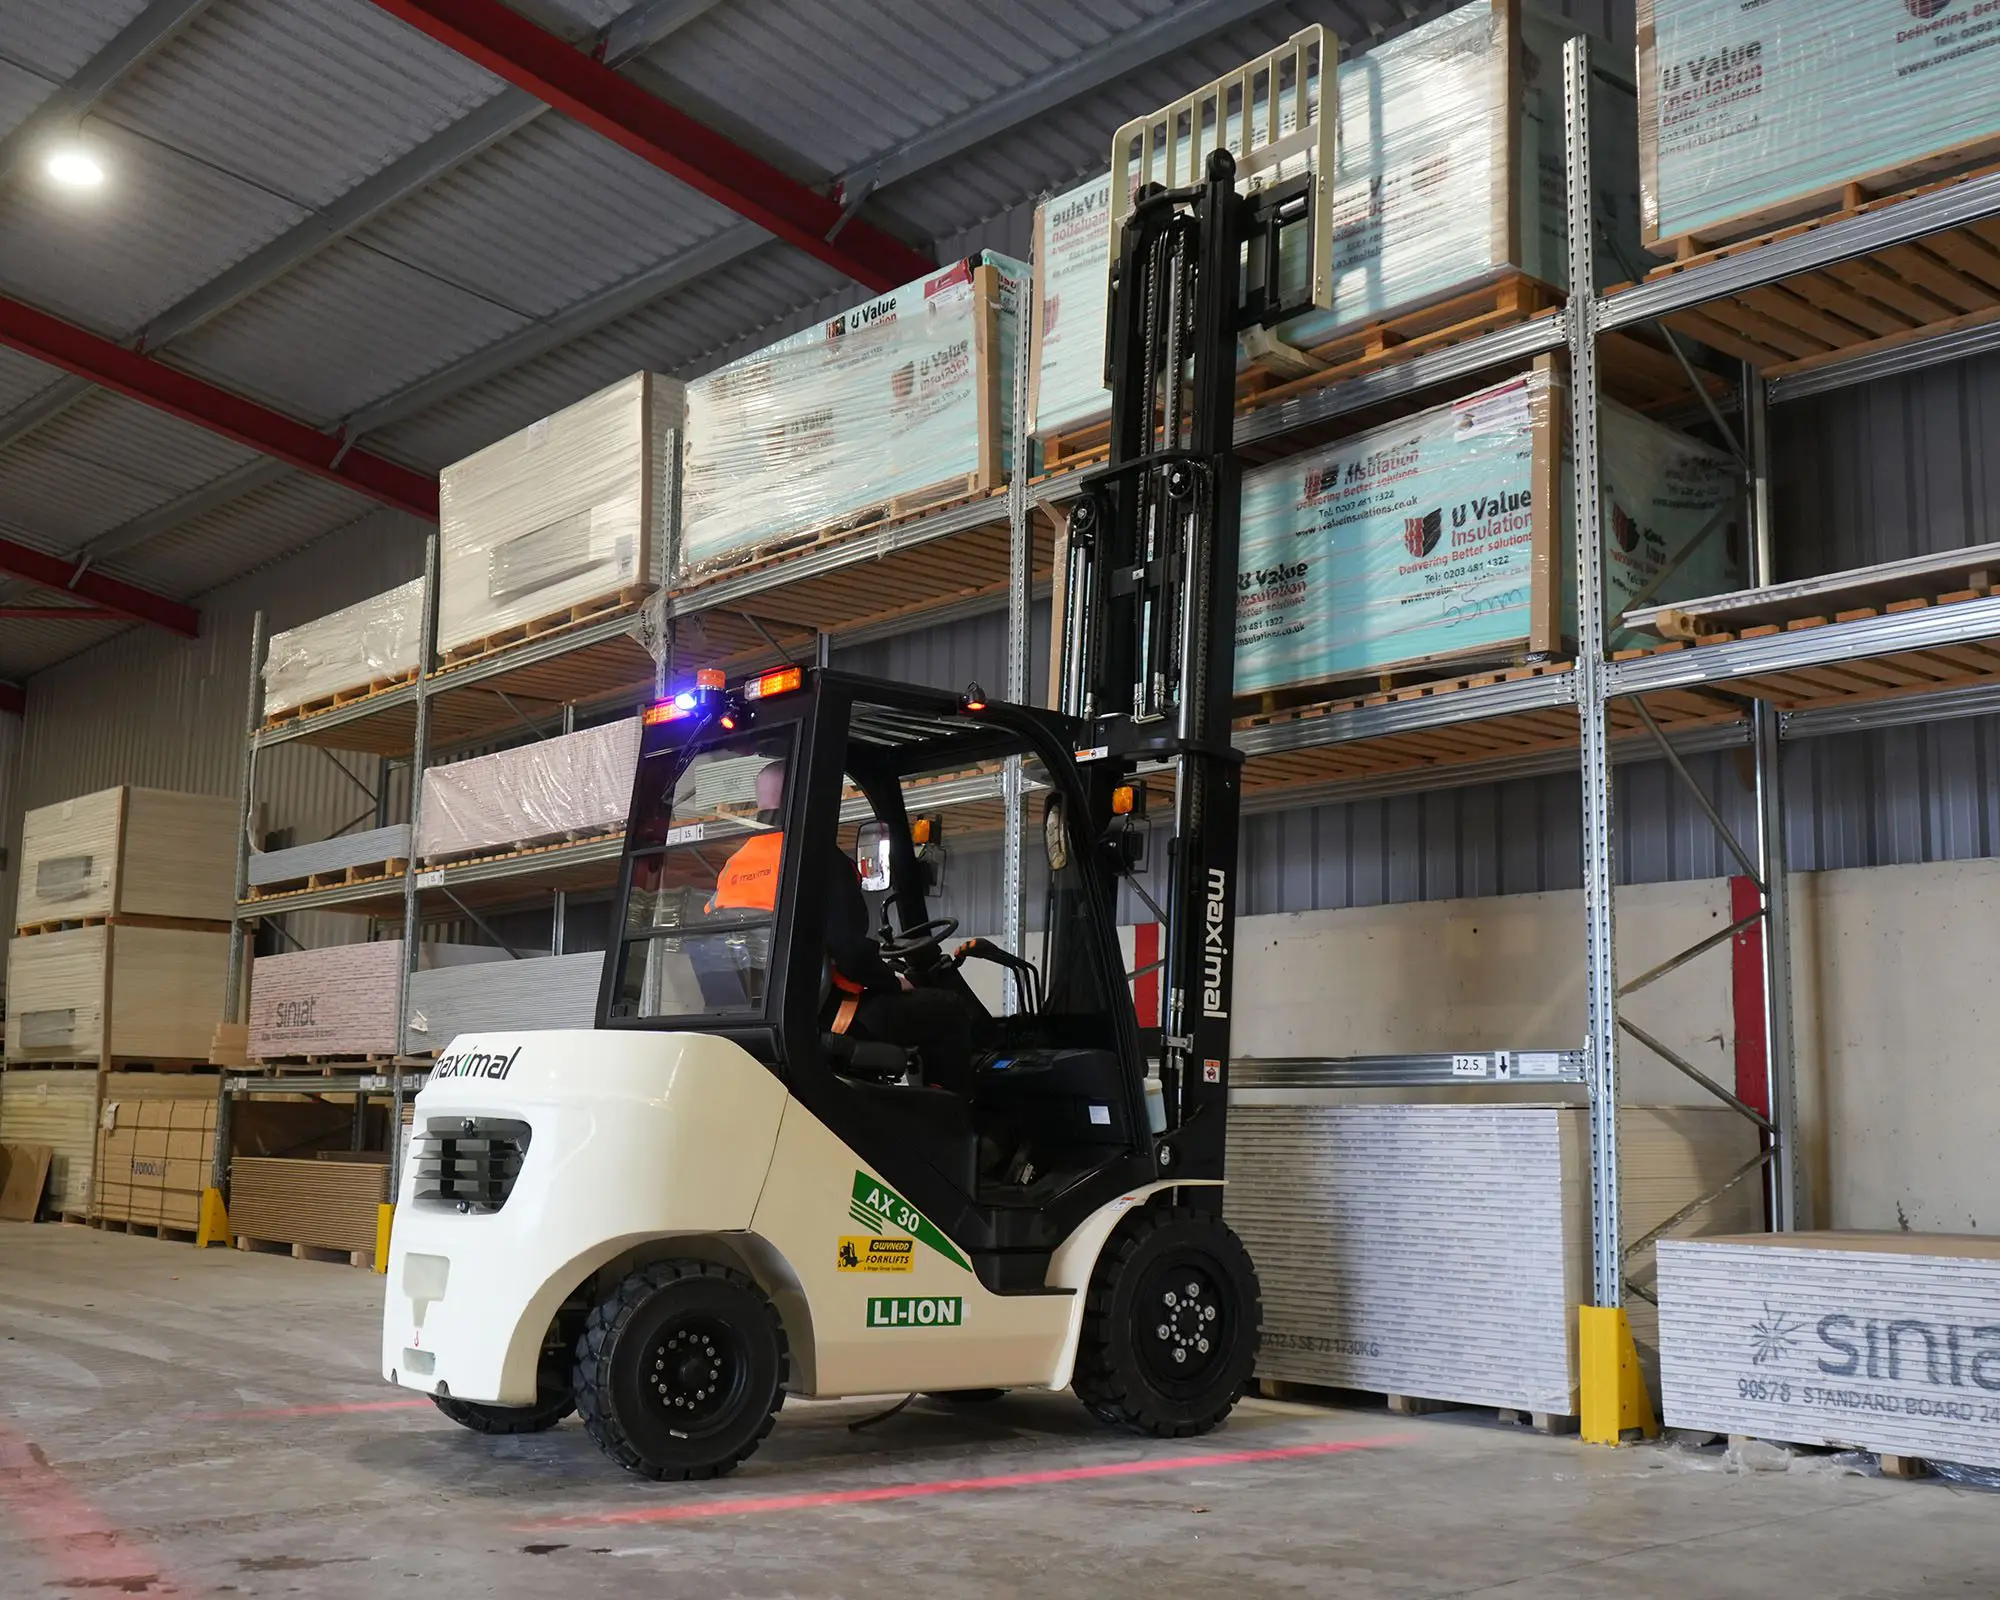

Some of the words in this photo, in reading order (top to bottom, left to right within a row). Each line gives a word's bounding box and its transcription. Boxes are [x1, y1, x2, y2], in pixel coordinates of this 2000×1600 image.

[1687, 41, 1762, 82] Value
[862, 298, 897, 323] Value
[1451, 503, 1467, 529] U
[1471, 489, 1532, 521] Value
[1451, 512, 1532, 547] Insulation
[1398, 555, 1448, 577] Delivering
[1451, 544, 1485, 562] Better
[1487, 531, 1532, 552] solutions
[1424, 573, 1442, 585] Tel:
[1443, 566, 1465, 580] 0203
[1467, 562, 1484, 574] 481
[1487, 554, 1510, 568] 1322
[1256, 562, 1308, 587] Value
[739, 868, 772, 883] maximal
[1202, 867, 1229, 1019] maximal
[1456, 1058, 1479, 1070] 12.5
[865, 1188, 895, 1217] AX
[897, 1207, 920, 1232] 30
[865, 1255, 909, 1264] FORKLIFTS
[873, 1241, 910, 1251] GWYNEDD
[873, 1299, 956, 1325] LI-ION
[1804, 1387, 1898, 1412] STANDARD
[1906, 1397, 1972, 1421] BOARD
